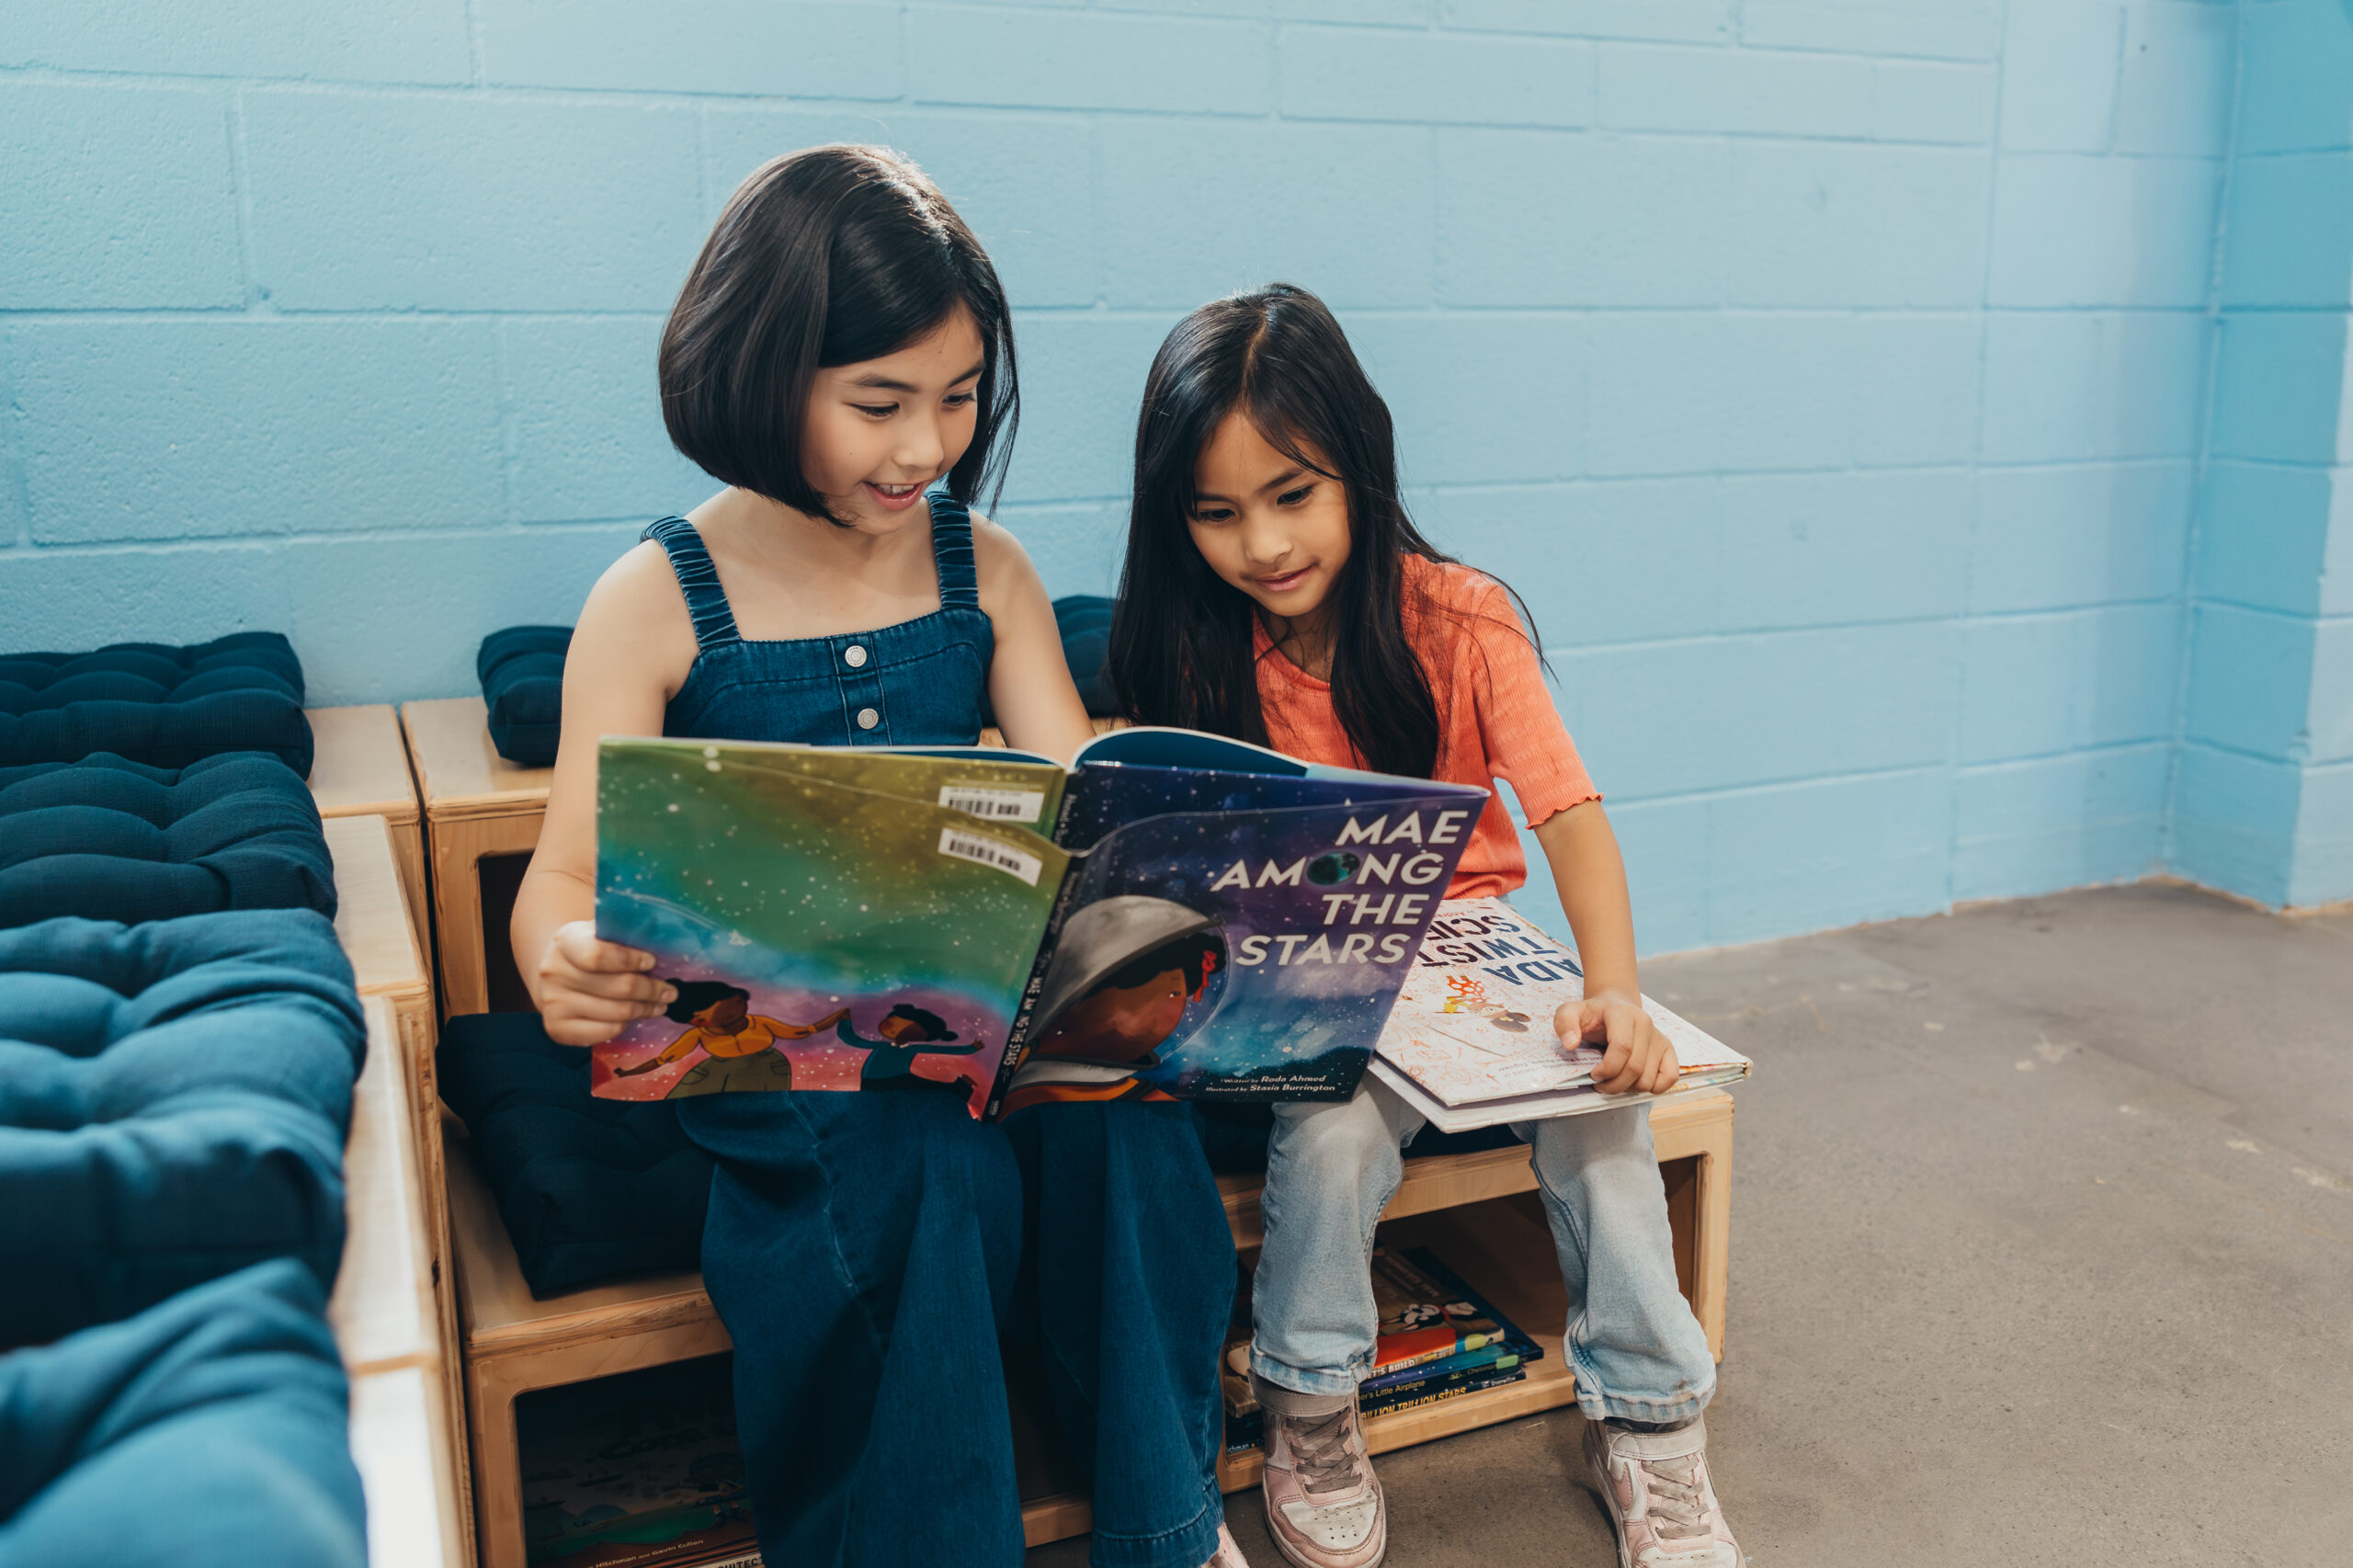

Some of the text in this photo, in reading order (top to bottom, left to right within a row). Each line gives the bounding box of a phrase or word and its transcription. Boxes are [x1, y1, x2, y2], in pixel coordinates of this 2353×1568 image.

[1335, 810, 1469, 846] MAE
[1210, 851, 1445, 892] AMONG
[1322, 893, 1430, 926] THE
[1427, 915, 1521, 941] SCIE
[1234, 932, 1412, 967] STARS
[1414, 936, 1558, 969] TWIST
[1482, 958, 1585, 986] ADA
[1249, 1084, 1279, 1092] Stasia
[1282, 1084, 1336, 1092] Burrington
[1289, 1074, 1327, 1083] Ahmed
[1388, 1359, 1415, 1373] BUILD
[1375, 1387, 1393, 1397] Little
[1395, 1380, 1427, 1392] Airplane
